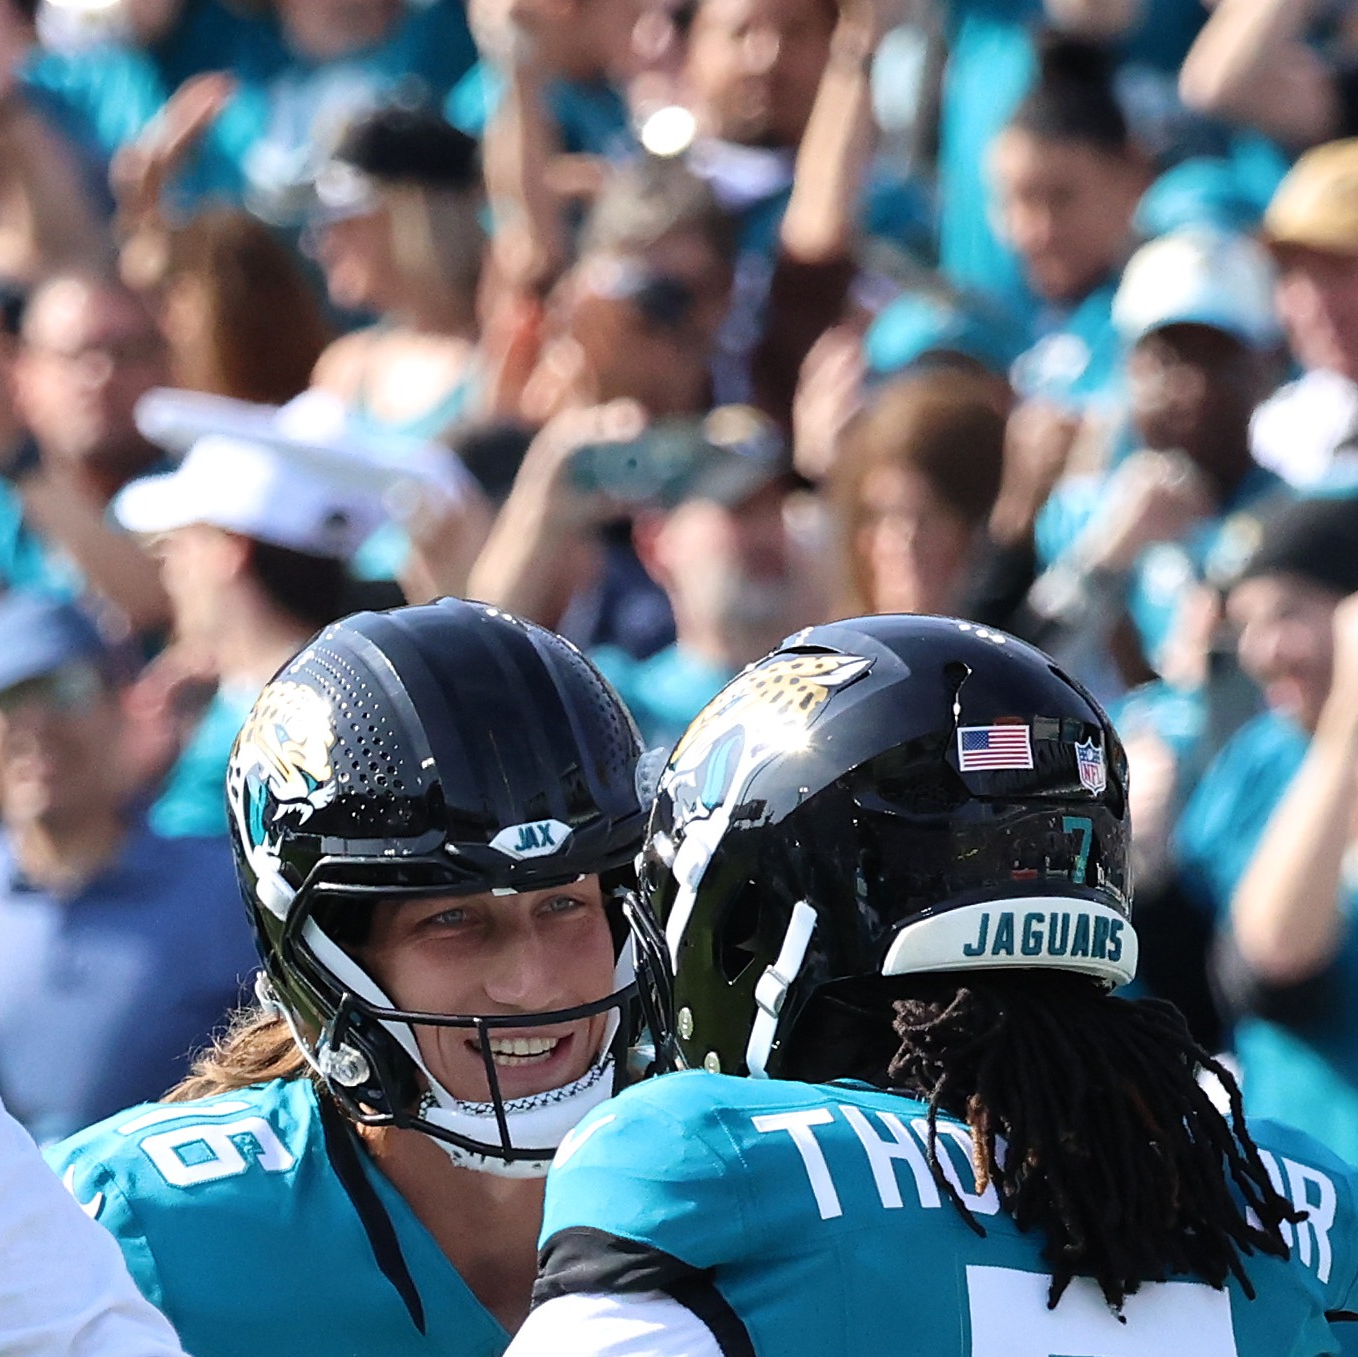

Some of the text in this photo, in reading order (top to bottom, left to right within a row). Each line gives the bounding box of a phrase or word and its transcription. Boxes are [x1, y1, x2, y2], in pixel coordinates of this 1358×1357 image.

[1079, 762, 1105, 787] NFL
[514, 822, 556, 852] JAX
[1062, 815, 1094, 884] 7
[963, 911, 1125, 963] JAGUARS
